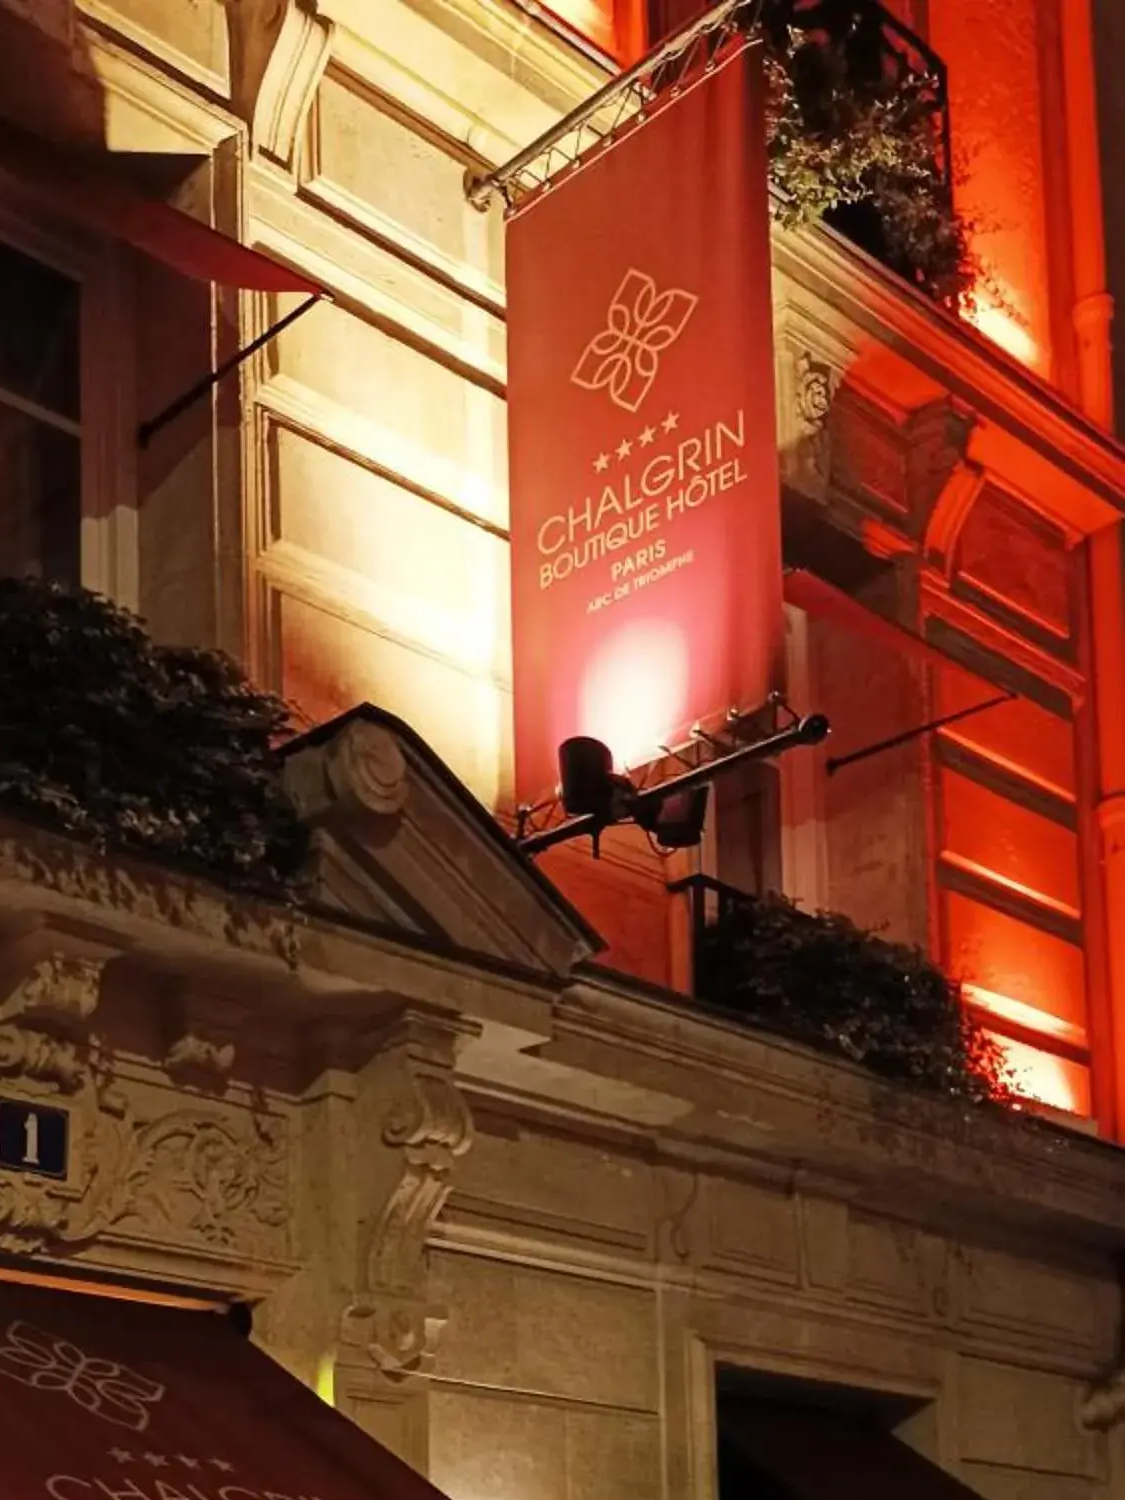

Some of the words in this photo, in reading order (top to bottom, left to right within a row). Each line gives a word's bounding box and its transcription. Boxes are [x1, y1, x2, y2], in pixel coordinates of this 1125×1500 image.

[537, 409, 745, 555] CHALGRIN
[539, 503, 661, 590] BOUTIQUE
[666, 458, 748, 520] HÔTEL
[610, 538, 666, 582] PARIS
[22, 1112, 40, 1165] 1
